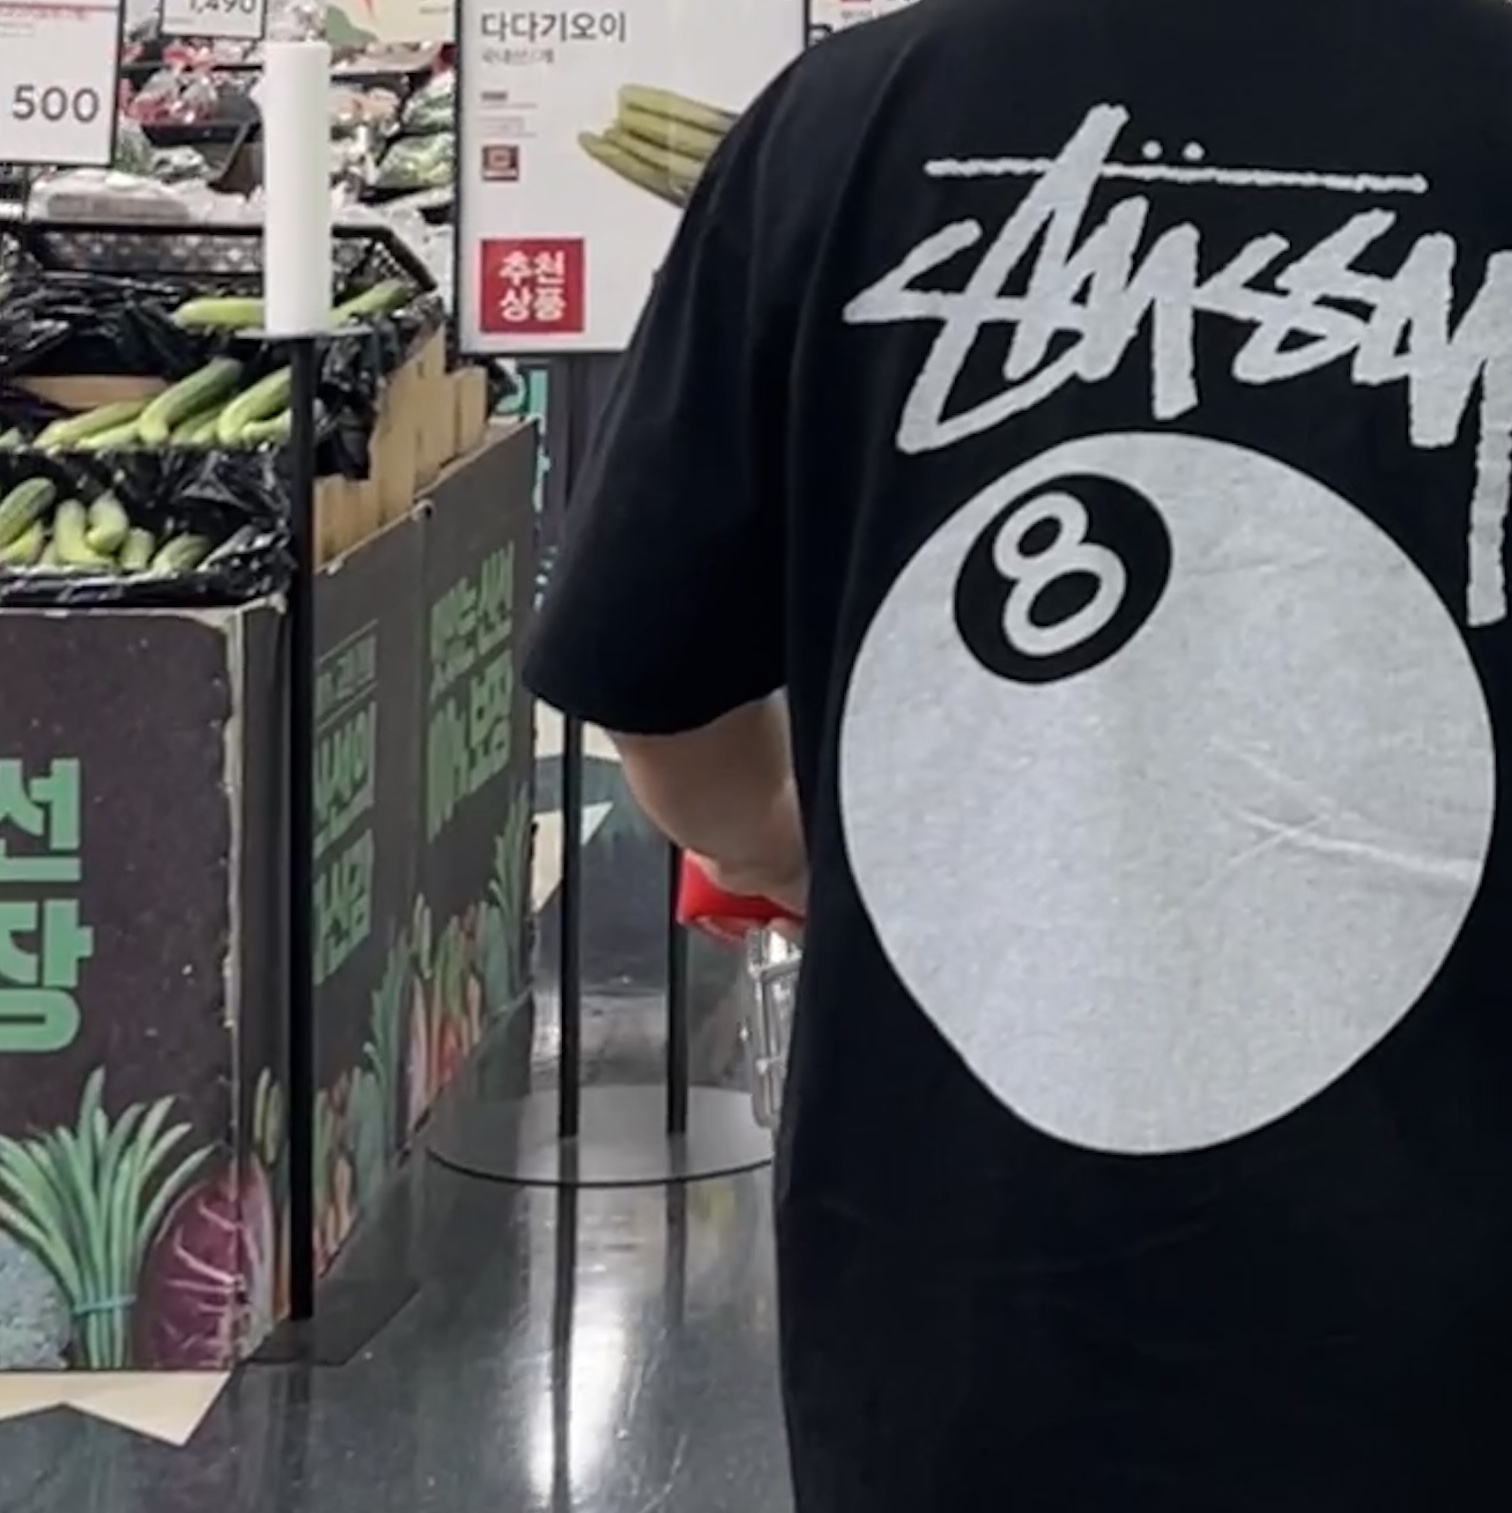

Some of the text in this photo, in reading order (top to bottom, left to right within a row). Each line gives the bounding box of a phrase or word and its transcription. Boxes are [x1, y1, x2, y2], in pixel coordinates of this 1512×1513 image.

[481, 11, 626, 42] 다다기오이
[499, 250, 566, 286] 추천
[499, 286, 566, 322] 상품
[993, 491, 1127, 657] 8
[0, 756, 82, 882] 선
[0, 898, 94, 1051] 장
